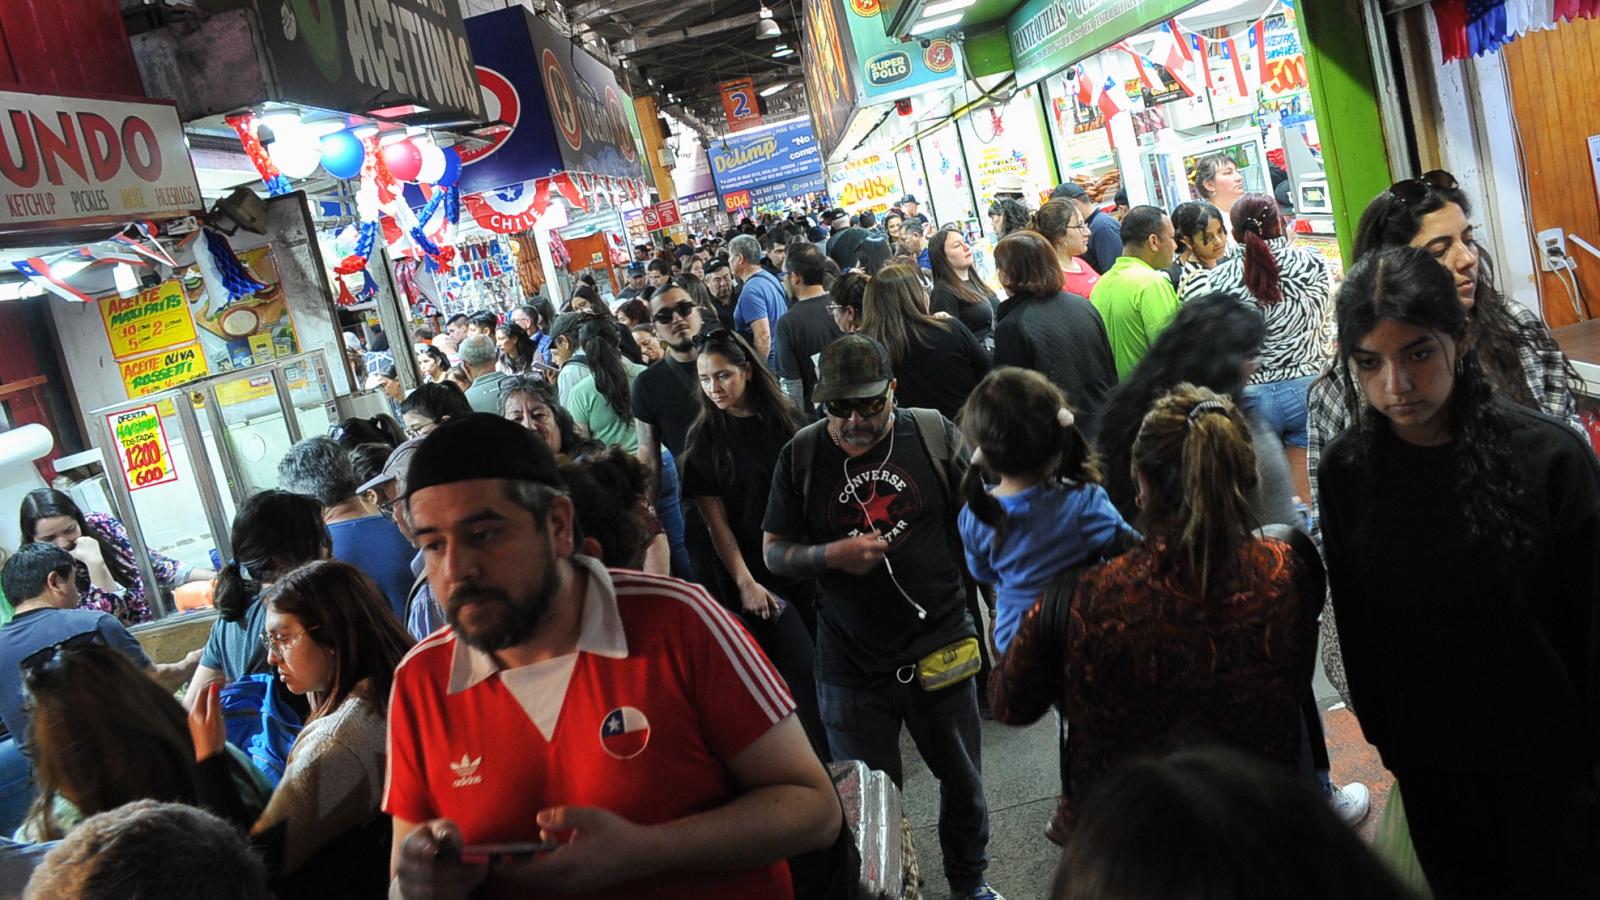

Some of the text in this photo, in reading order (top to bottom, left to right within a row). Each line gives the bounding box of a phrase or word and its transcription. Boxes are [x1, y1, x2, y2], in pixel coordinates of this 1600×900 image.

[1012, 2, 1067, 55] MANTEQUILLAS
[344, 0, 480, 115] ACEITUNAS
[870, 56, 905, 72] SUPER
[872, 65, 908, 81] POLLO
[1266, 55, 1307, 94] 500
[730, 91, 751, 118] 2
[714, 137, 777, 173] Delimp
[6, 191, 56, 217] KETCHUP
[71, 189, 110, 213] PICKLES
[155, 186, 195, 207] HUESILLOS
[726, 193, 749, 208] 604
[490, 208, 542, 230] CHILE
[460, 240, 501, 261] VIVA
[458, 255, 513, 281] CHILE
[108, 290, 160, 316] ACEITE
[122, 325, 137, 337] 10
[152, 321, 163, 336] 2
[124, 350, 194, 379] ACEITE OLIVA
[132, 362, 192, 389] ROSSETTI
[118, 411, 147, 424] OFERTA
[121, 433, 155, 447] TOSTADA
[126, 440, 161, 472] 1200
[136, 467, 163, 486] 600
[839, 470, 907, 503] CONVERSE
[877, 519, 908, 543] STAR
[452, 776, 481, 788] adidas
